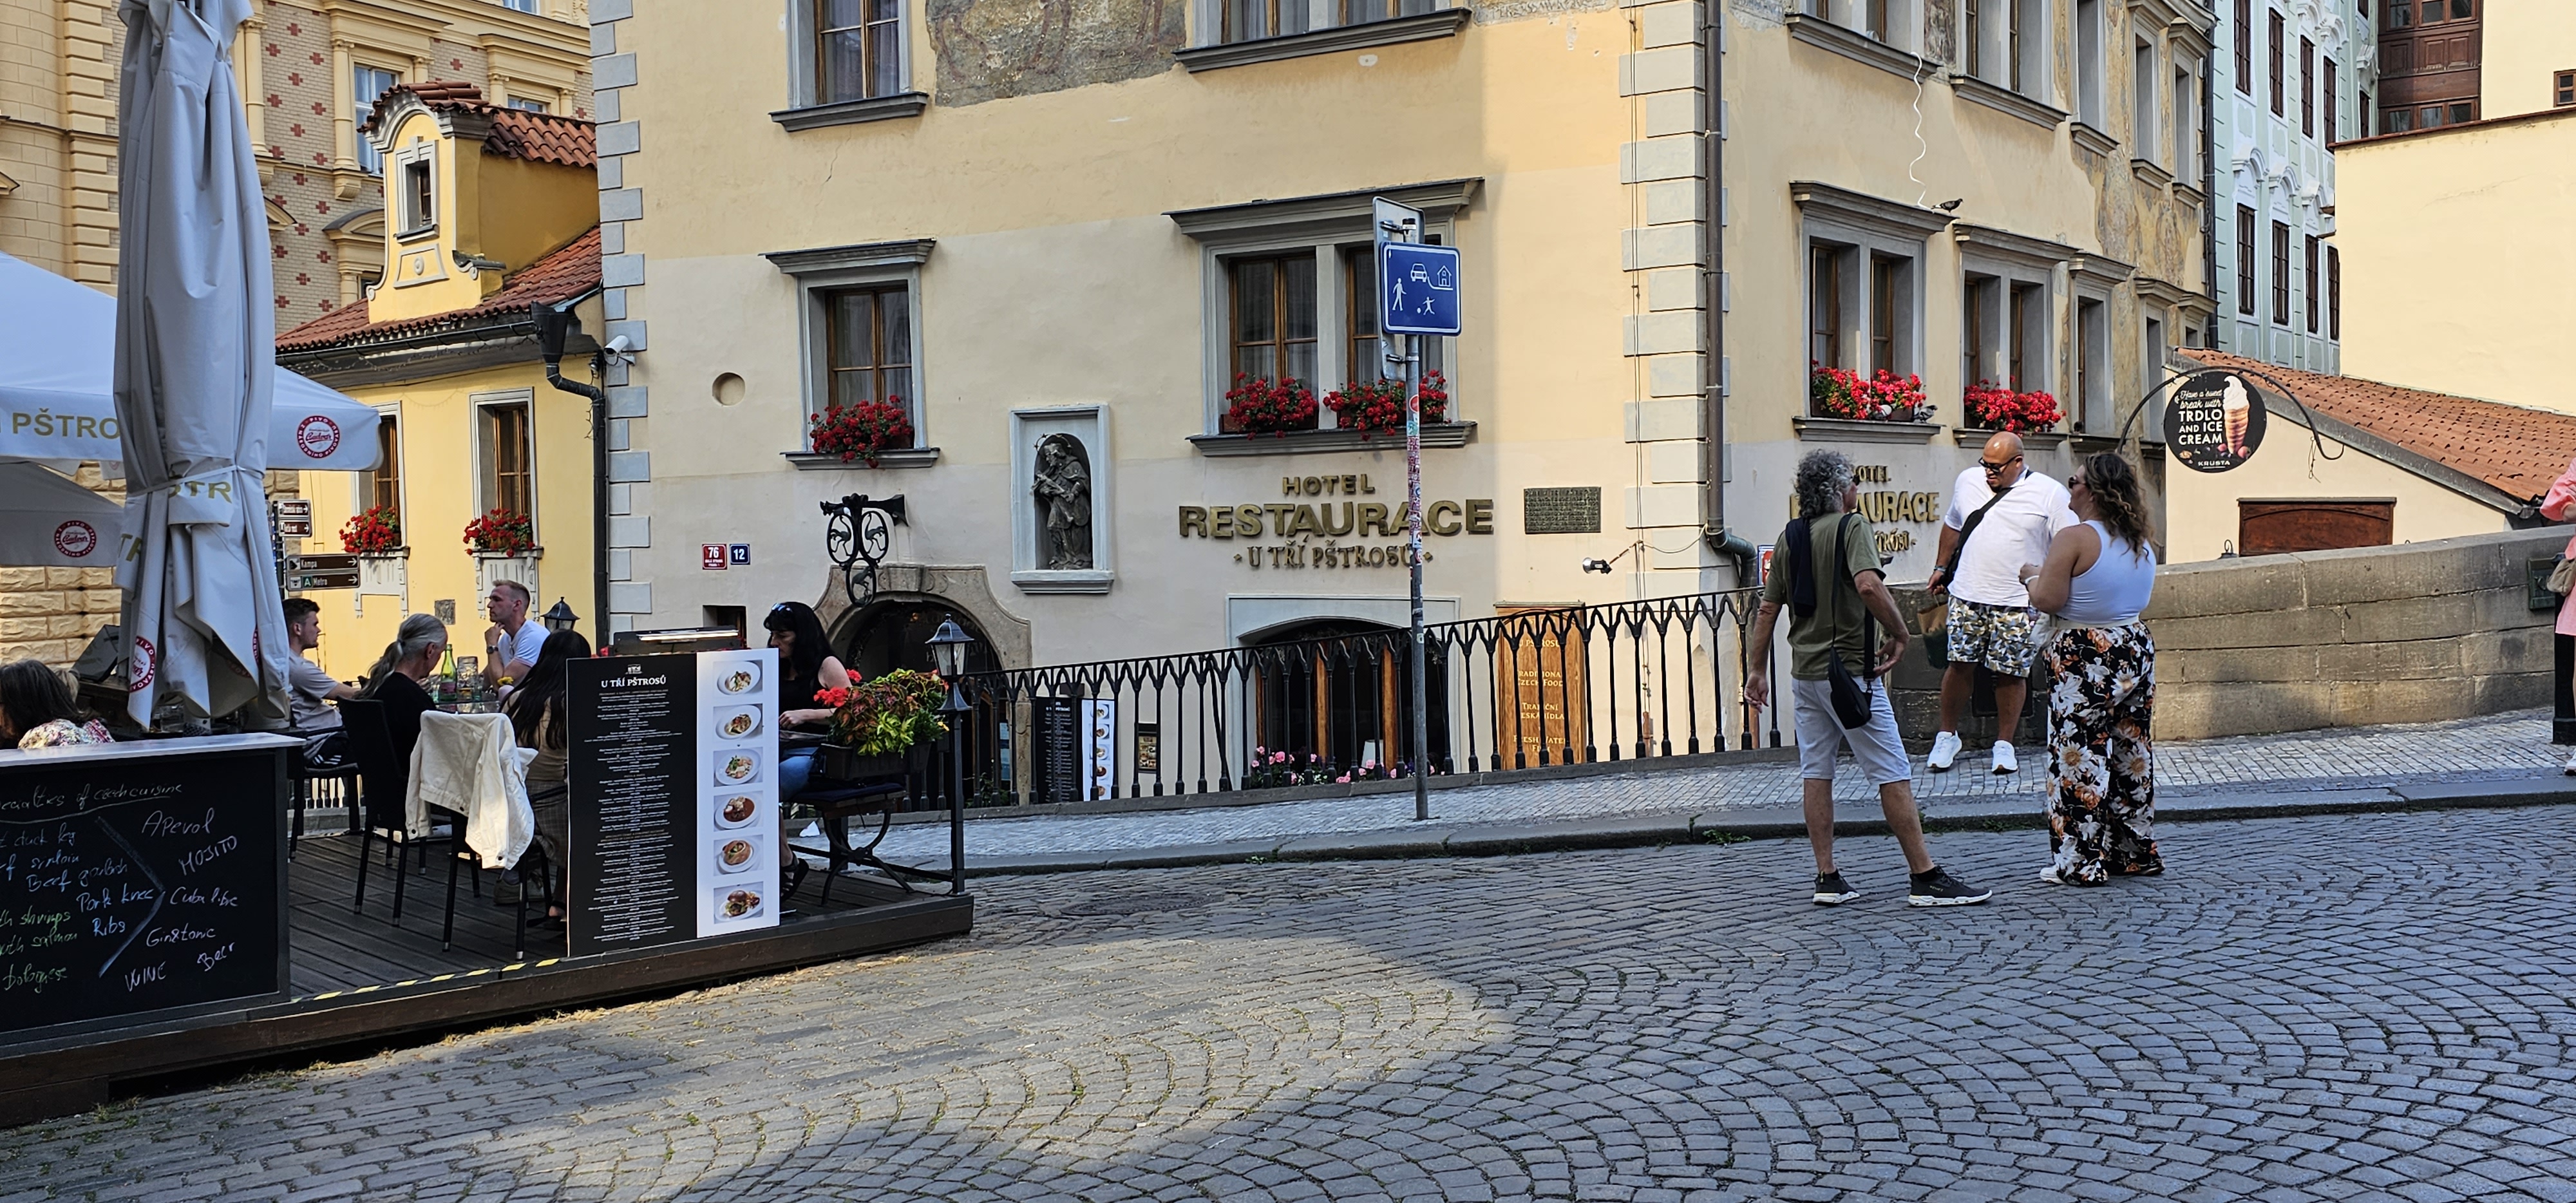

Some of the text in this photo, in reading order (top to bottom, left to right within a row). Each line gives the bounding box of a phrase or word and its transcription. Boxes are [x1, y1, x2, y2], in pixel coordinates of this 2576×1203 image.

[2180, 399, 2203, 409] break
[2179, 409, 2222, 422] TRDLO
[2179, 422, 2222, 433] AND ICE
[2179, 433, 2222, 445] CREAM
[1854, 466, 1892, 482] OTEL
[1282, 474, 1376, 495] HOTEL
[1790, 491, 1940, 523] AURACE
[1179, 498, 1494, 538] RESTAURACE
[708, 546, 719, 558] 76
[733, 549, 746, 560] 12
[1246, 546, 1263, 567] U
[1267, 535, 1310, 568] TŘÍ
[301, 559, 318, 569] Kampa
[304, 578, 312, 587] A
[609, 677, 625, 687] TŘÍ
[627, 674, 667, 687] PŠTROSŮ
[1522, 702, 1559, 711] TRAČNÍ
[1521, 711, 1540, 719] ESKÁ
[1513, 735, 1566, 744] FESH ATE
[1532, 744, 1551, 753] FI
[14, 828, 48, 847] duck
[178, 835, 238, 876] MOJITO
[26, 869, 71, 893] Beef
[75, 887, 112, 913] Pork
[169, 886, 205, 905] Cuba
[91, 915, 126, 936] Ribs
[196, 942, 236, 972] Beer
[124, 961, 167, 992] WINE
